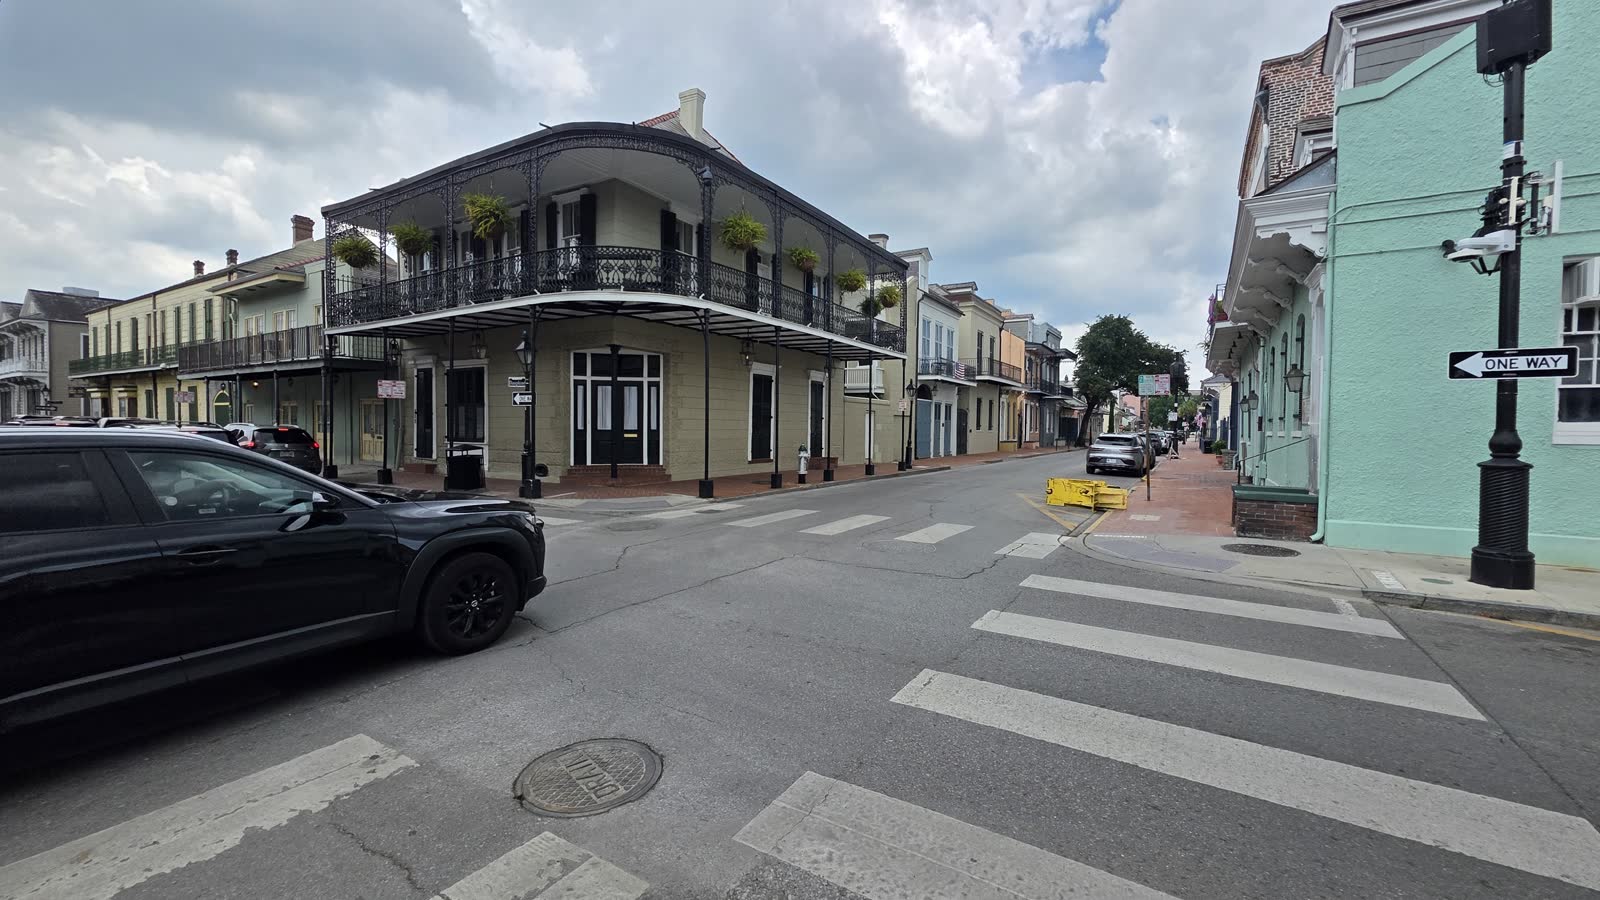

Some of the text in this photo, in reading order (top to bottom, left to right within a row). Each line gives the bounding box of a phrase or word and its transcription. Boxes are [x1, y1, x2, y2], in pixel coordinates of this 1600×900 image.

[1485, 356, 1562, 370] ONE WAY
[563, 752, 621, 799] DRAIN
